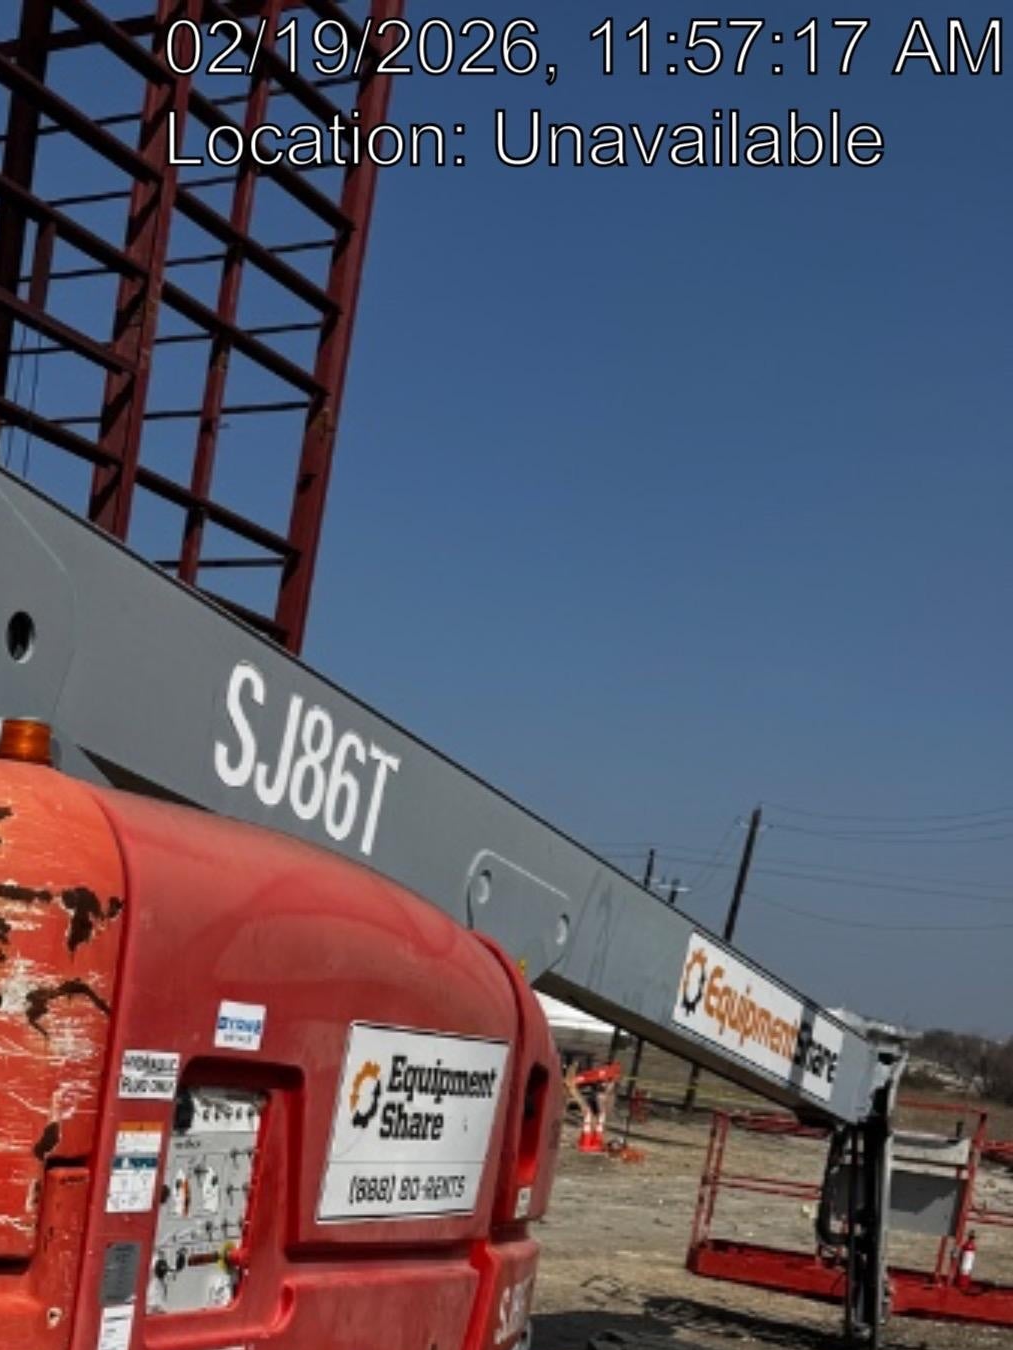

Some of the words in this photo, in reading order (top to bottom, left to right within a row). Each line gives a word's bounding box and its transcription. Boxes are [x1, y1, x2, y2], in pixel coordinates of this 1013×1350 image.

[215, 660, 401, 856] SJ86T
[386, 1055, 498, 1105] Equipment
[379, 1103, 445, 1141] Share
[348, 1174, 396, 1204] (888)
